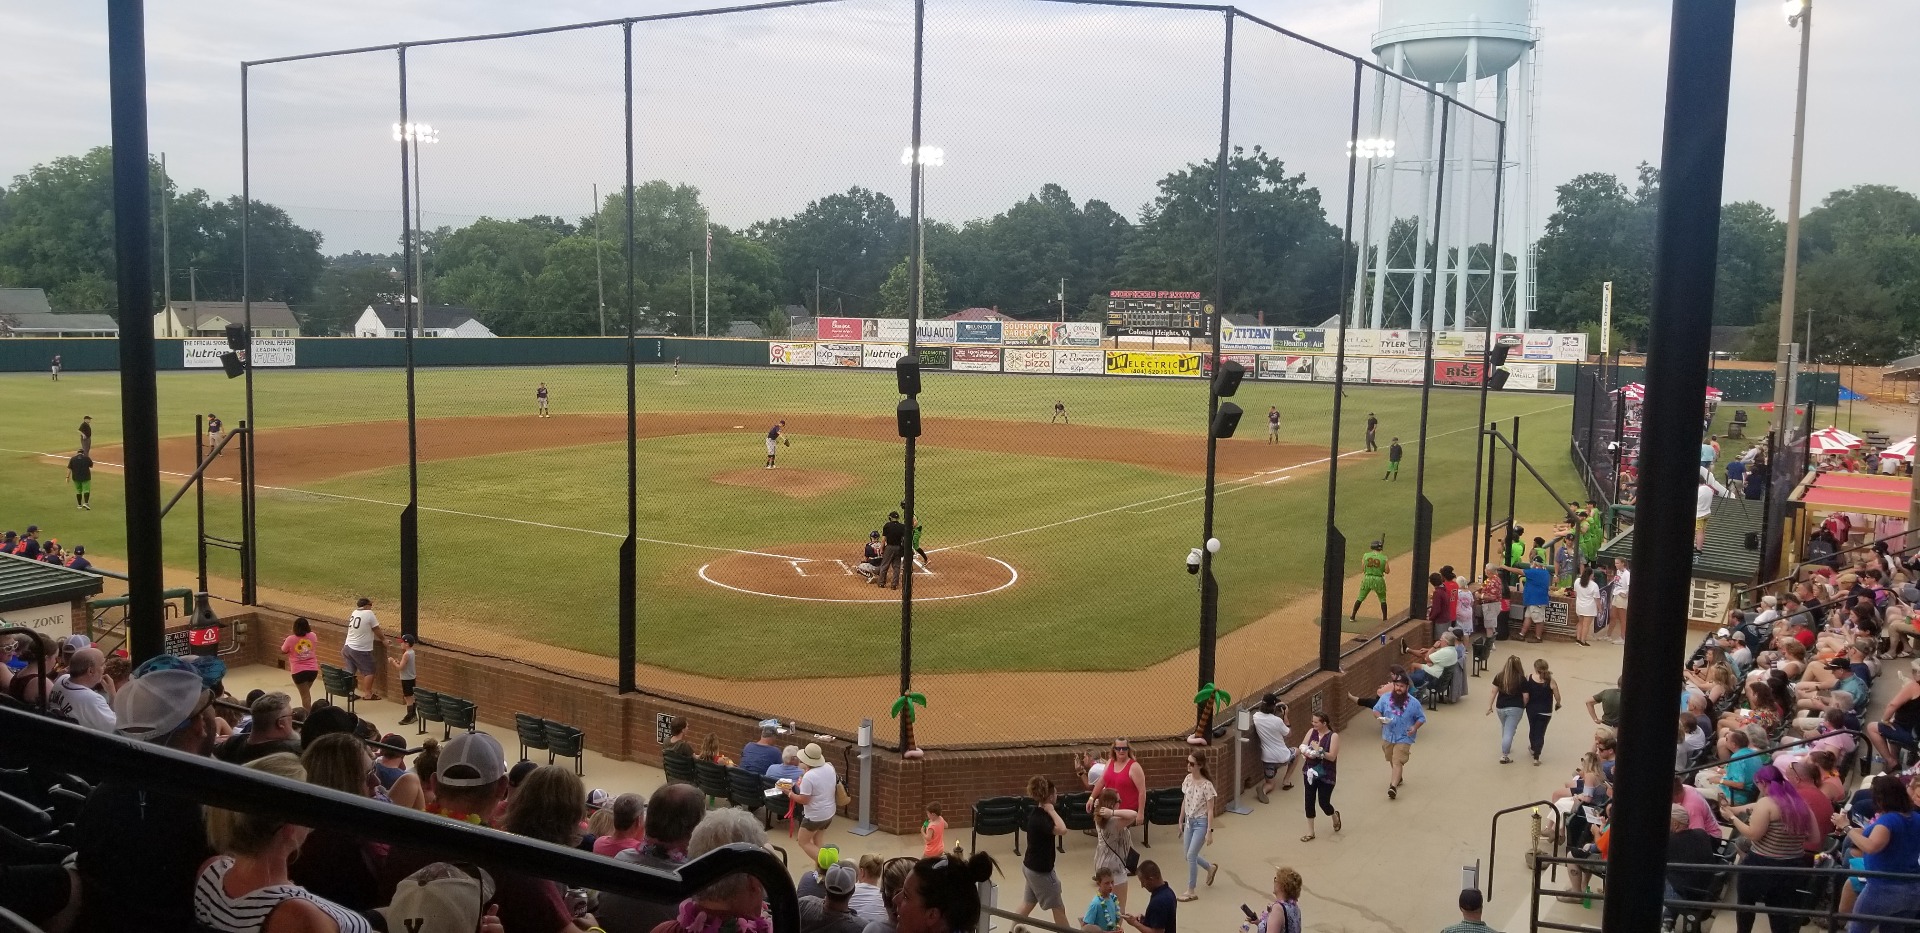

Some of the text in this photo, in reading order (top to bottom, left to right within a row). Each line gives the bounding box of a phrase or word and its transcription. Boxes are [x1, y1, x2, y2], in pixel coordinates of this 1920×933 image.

[1004, 329, 1032, 337] CARPET
[1235, 329, 1271, 339] TITAN
[254, 353, 294, 364] FIELD
[865, 349, 902, 359] Nutrien
[1025, 359, 1050, 368] pizza
[1107, 354, 1200, 372] JW ELECTRIC JW
[1446, 367, 1478, 377] RISE
[32, 614, 64, 628] ZONE
[349, 615, 361, 629] 20
[173, 631, 189, 640] ALERT
